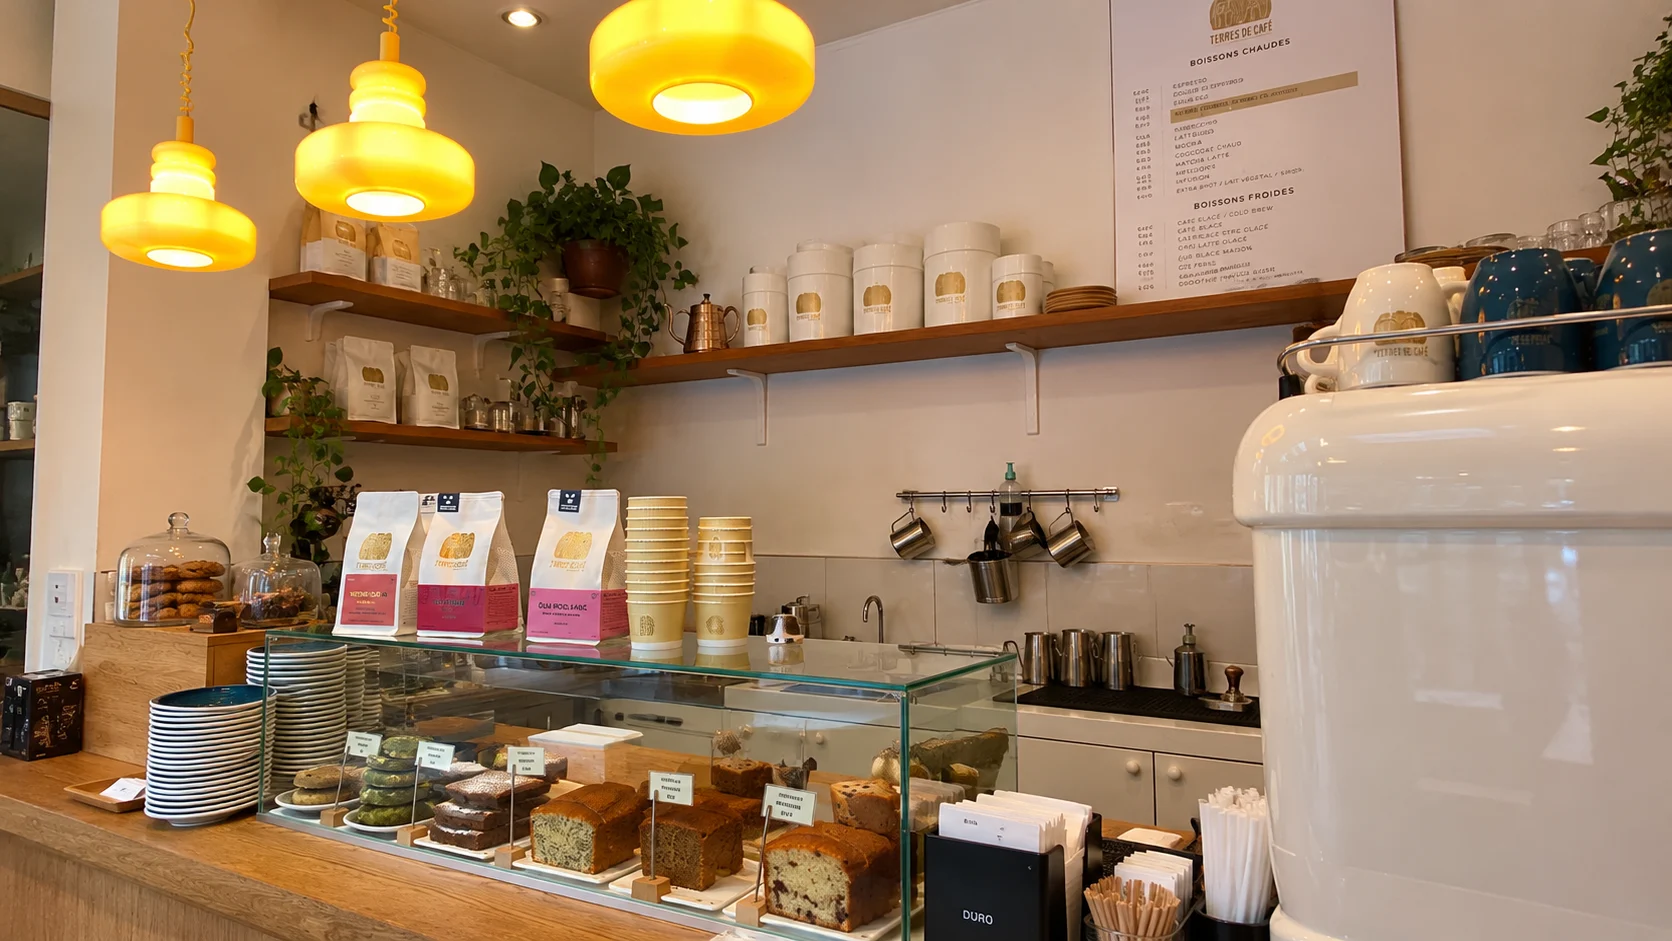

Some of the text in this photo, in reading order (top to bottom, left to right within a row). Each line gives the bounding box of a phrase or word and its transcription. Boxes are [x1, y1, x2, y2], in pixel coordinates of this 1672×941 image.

[1210, 19, 1273, 45] TERRES DE CAFÉ
[1190, 37, 1291, 67] BOISSONS CHAUDES
[1193, 186, 1295, 210] BOISSONS FROIDES
[963, 909, 994, 925] DURO
